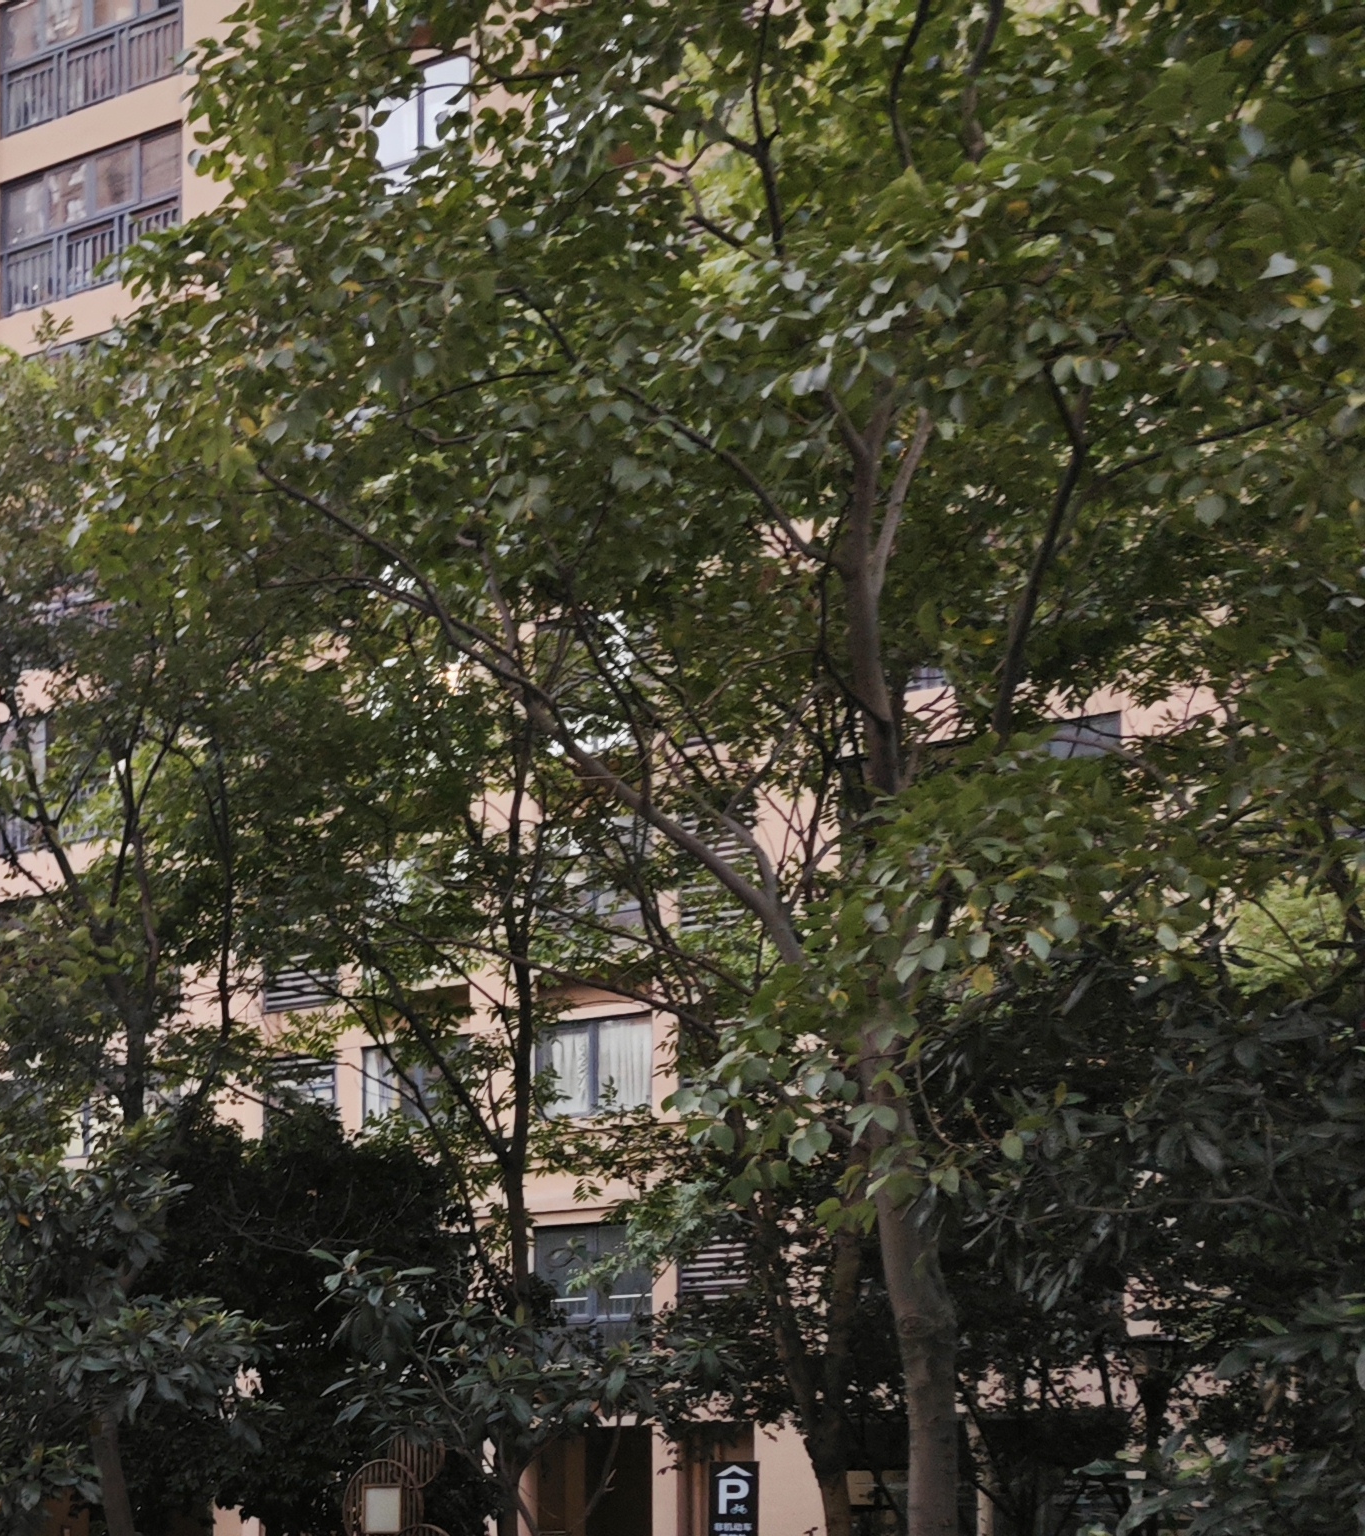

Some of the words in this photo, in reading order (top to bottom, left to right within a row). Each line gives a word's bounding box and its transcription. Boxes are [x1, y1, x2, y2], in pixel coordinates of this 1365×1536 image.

[718, 1478, 750, 1515] P
[713, 1522, 753, 1532] 非机动车
